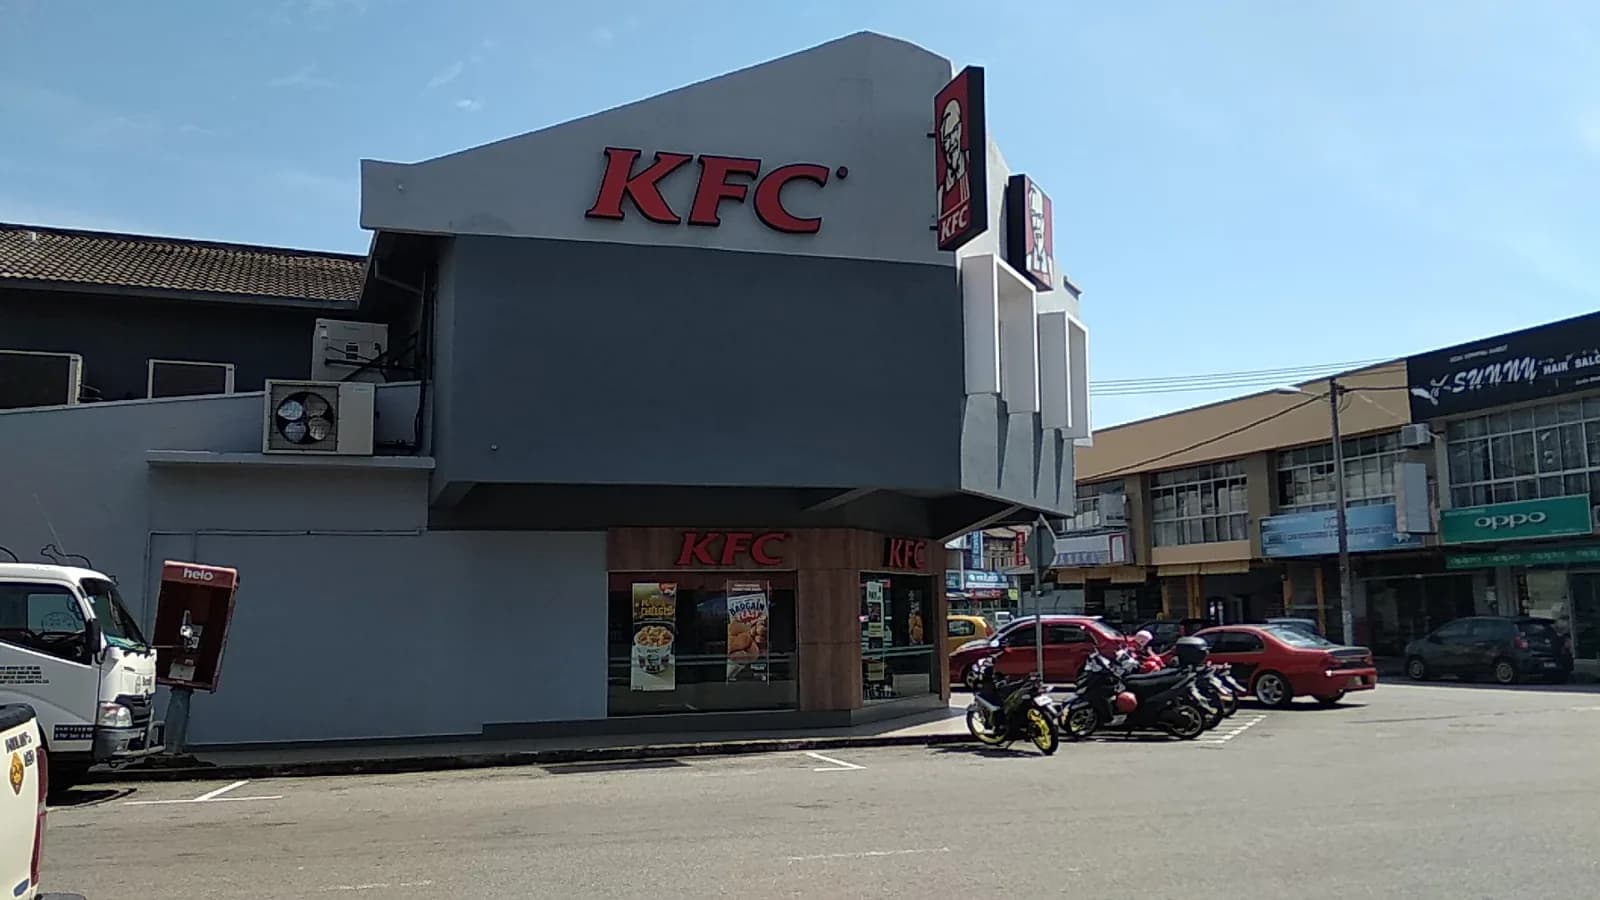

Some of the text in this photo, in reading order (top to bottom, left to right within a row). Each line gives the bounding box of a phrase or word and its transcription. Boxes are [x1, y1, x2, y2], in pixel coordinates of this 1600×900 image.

[585, 146, 831, 234] KFC
[939, 205, 970, 243] KFC
[1452, 356, 1537, 393] SUNNY
[1543, 361, 1569, 375] HAIR
[1474, 511, 1546, 530] oppo
[674, 531, 788, 567] KFC
[886, 537, 927, 570] KFC
[183, 567, 214, 582] helo
